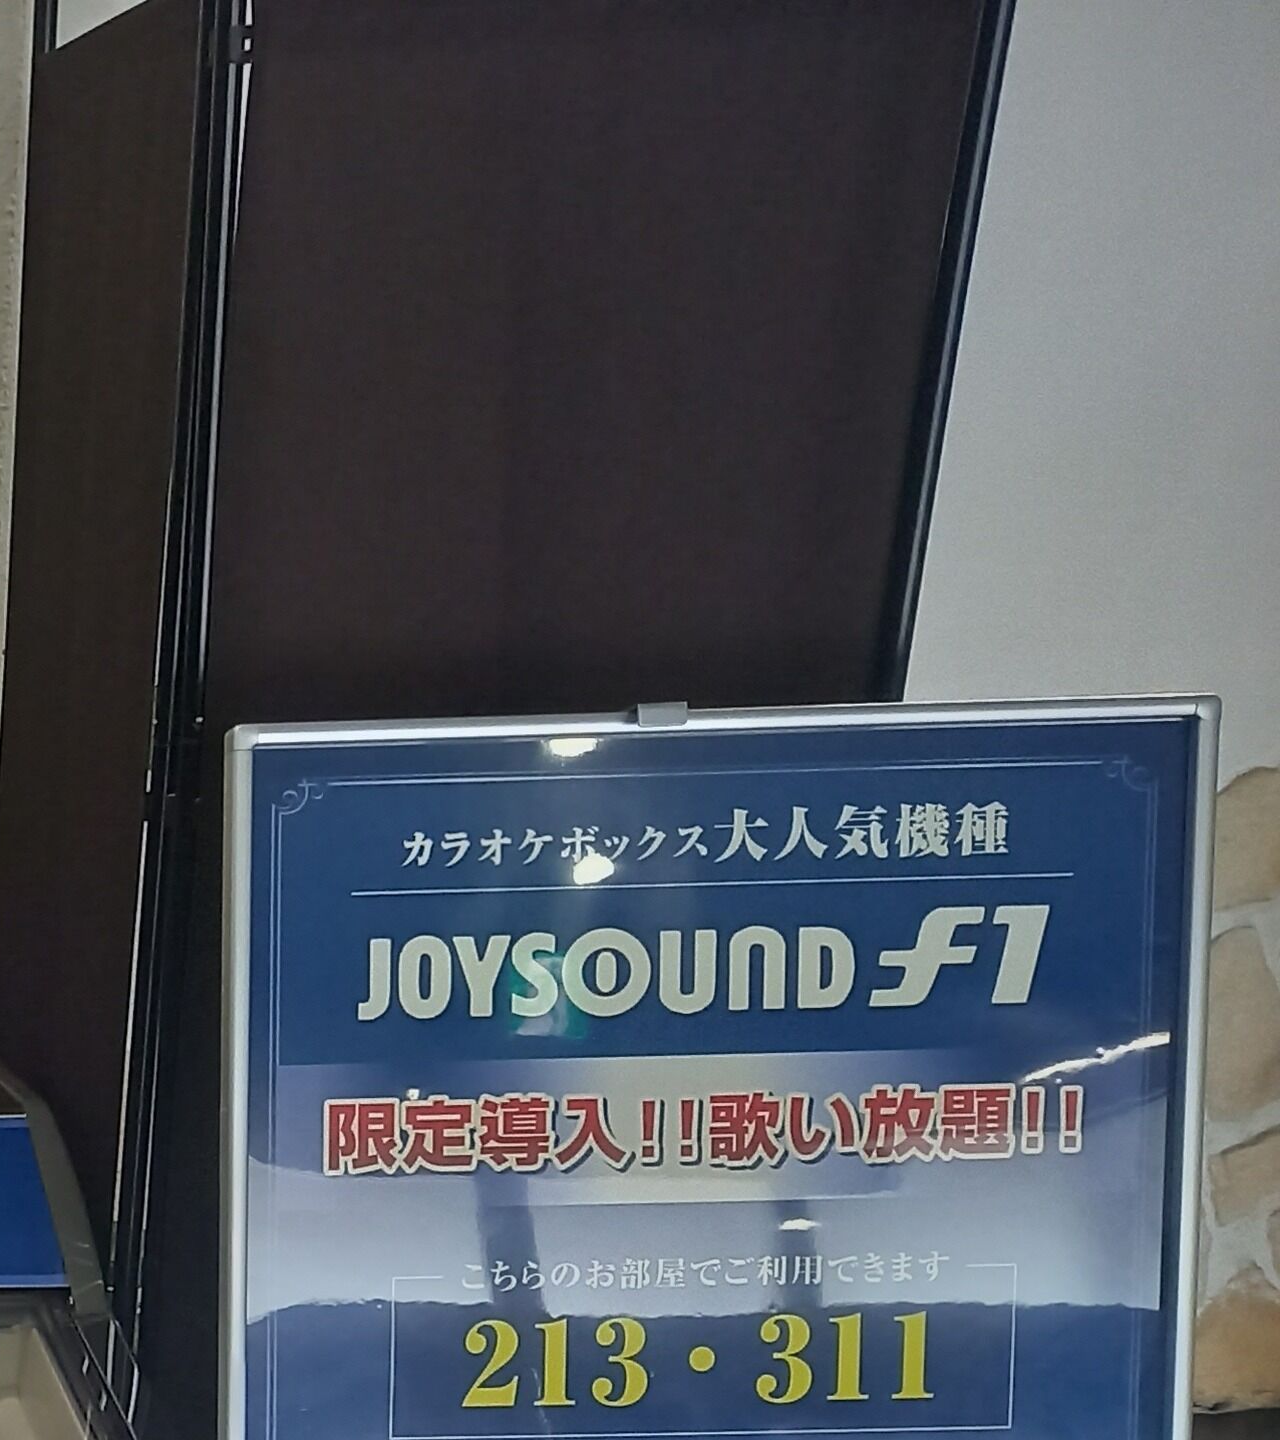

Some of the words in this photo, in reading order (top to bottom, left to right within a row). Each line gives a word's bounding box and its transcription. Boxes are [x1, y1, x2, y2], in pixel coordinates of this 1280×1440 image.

[401, 803, 1010, 869] カラオケボックス大人気機種
[357, 926, 855, 1021] JOYSOUND
[323, 1084, 1084, 1176] 限定導入!!歌い放題!!
[460, 1251, 950, 1292] こちらのお部屋でご利用できます
